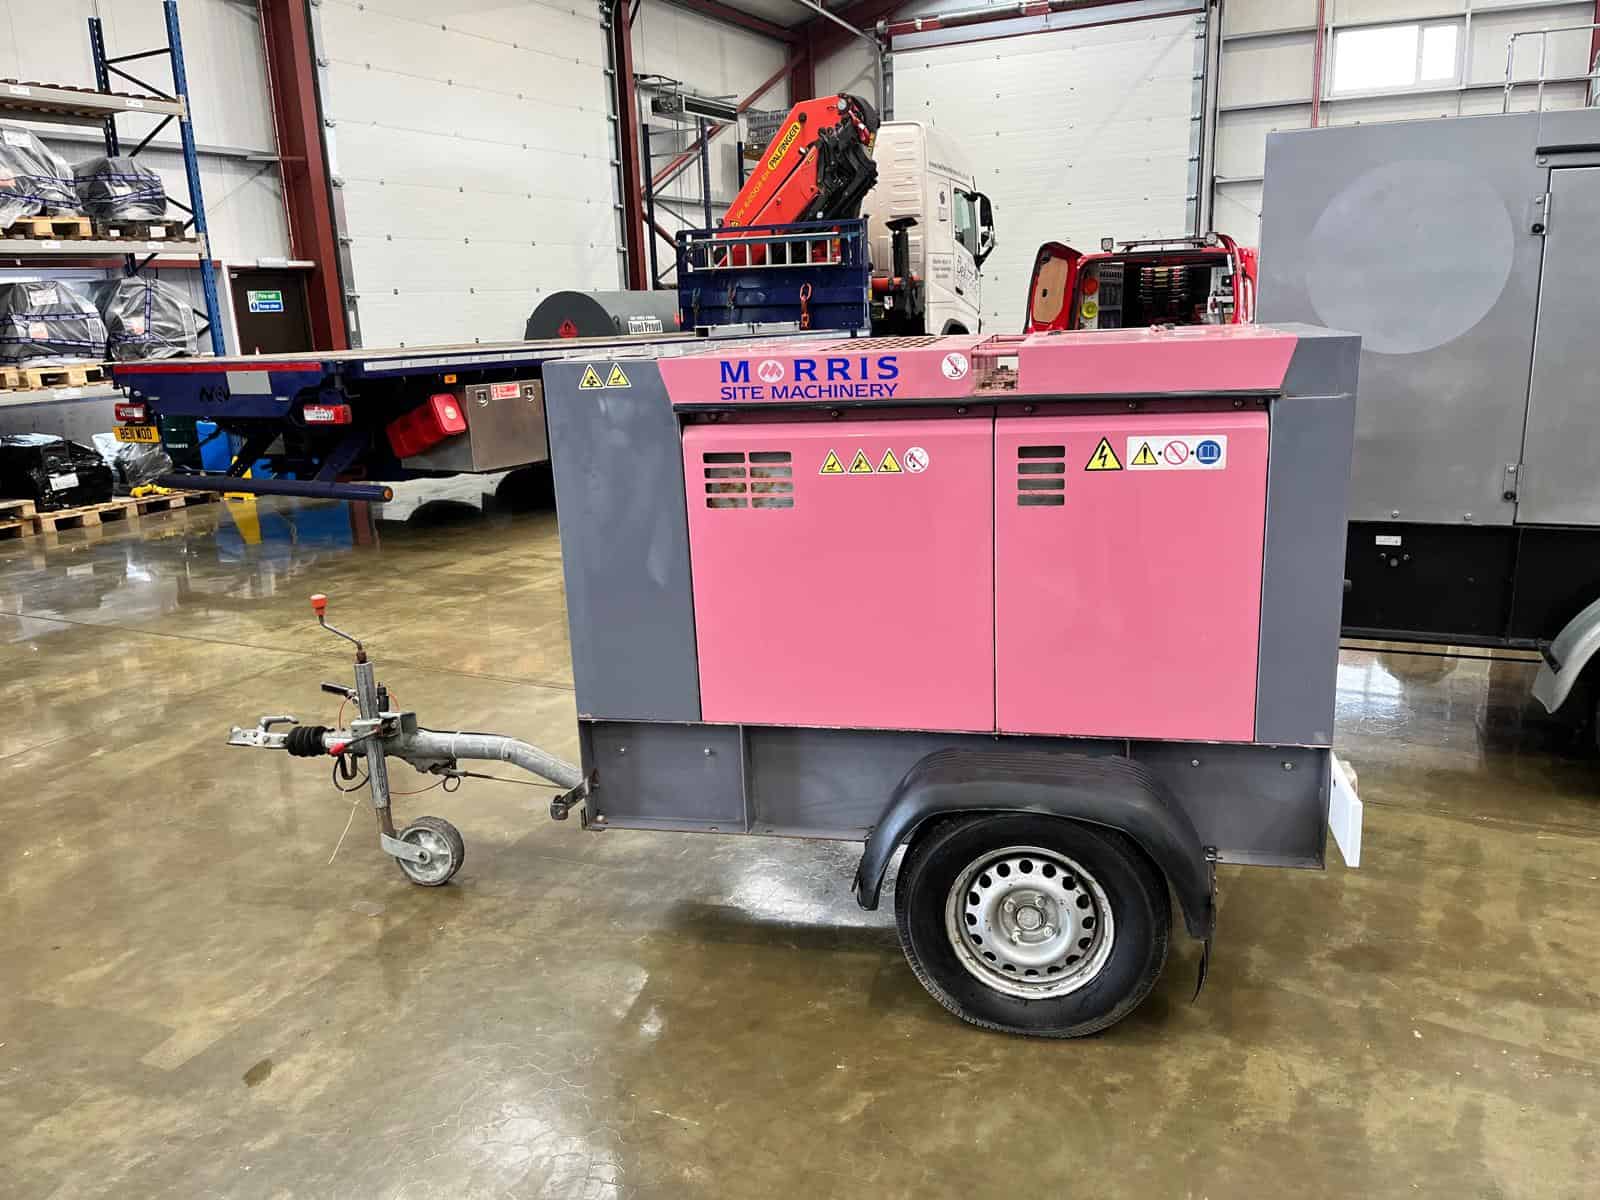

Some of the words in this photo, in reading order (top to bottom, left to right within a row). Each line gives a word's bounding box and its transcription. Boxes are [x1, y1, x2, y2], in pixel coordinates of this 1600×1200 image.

[769, 124, 800, 169] PALFINGER
[720, 356, 899, 383] MORRIS
[720, 386, 764, 401] SITE
[771, 383, 898, 399] MACHINERY
